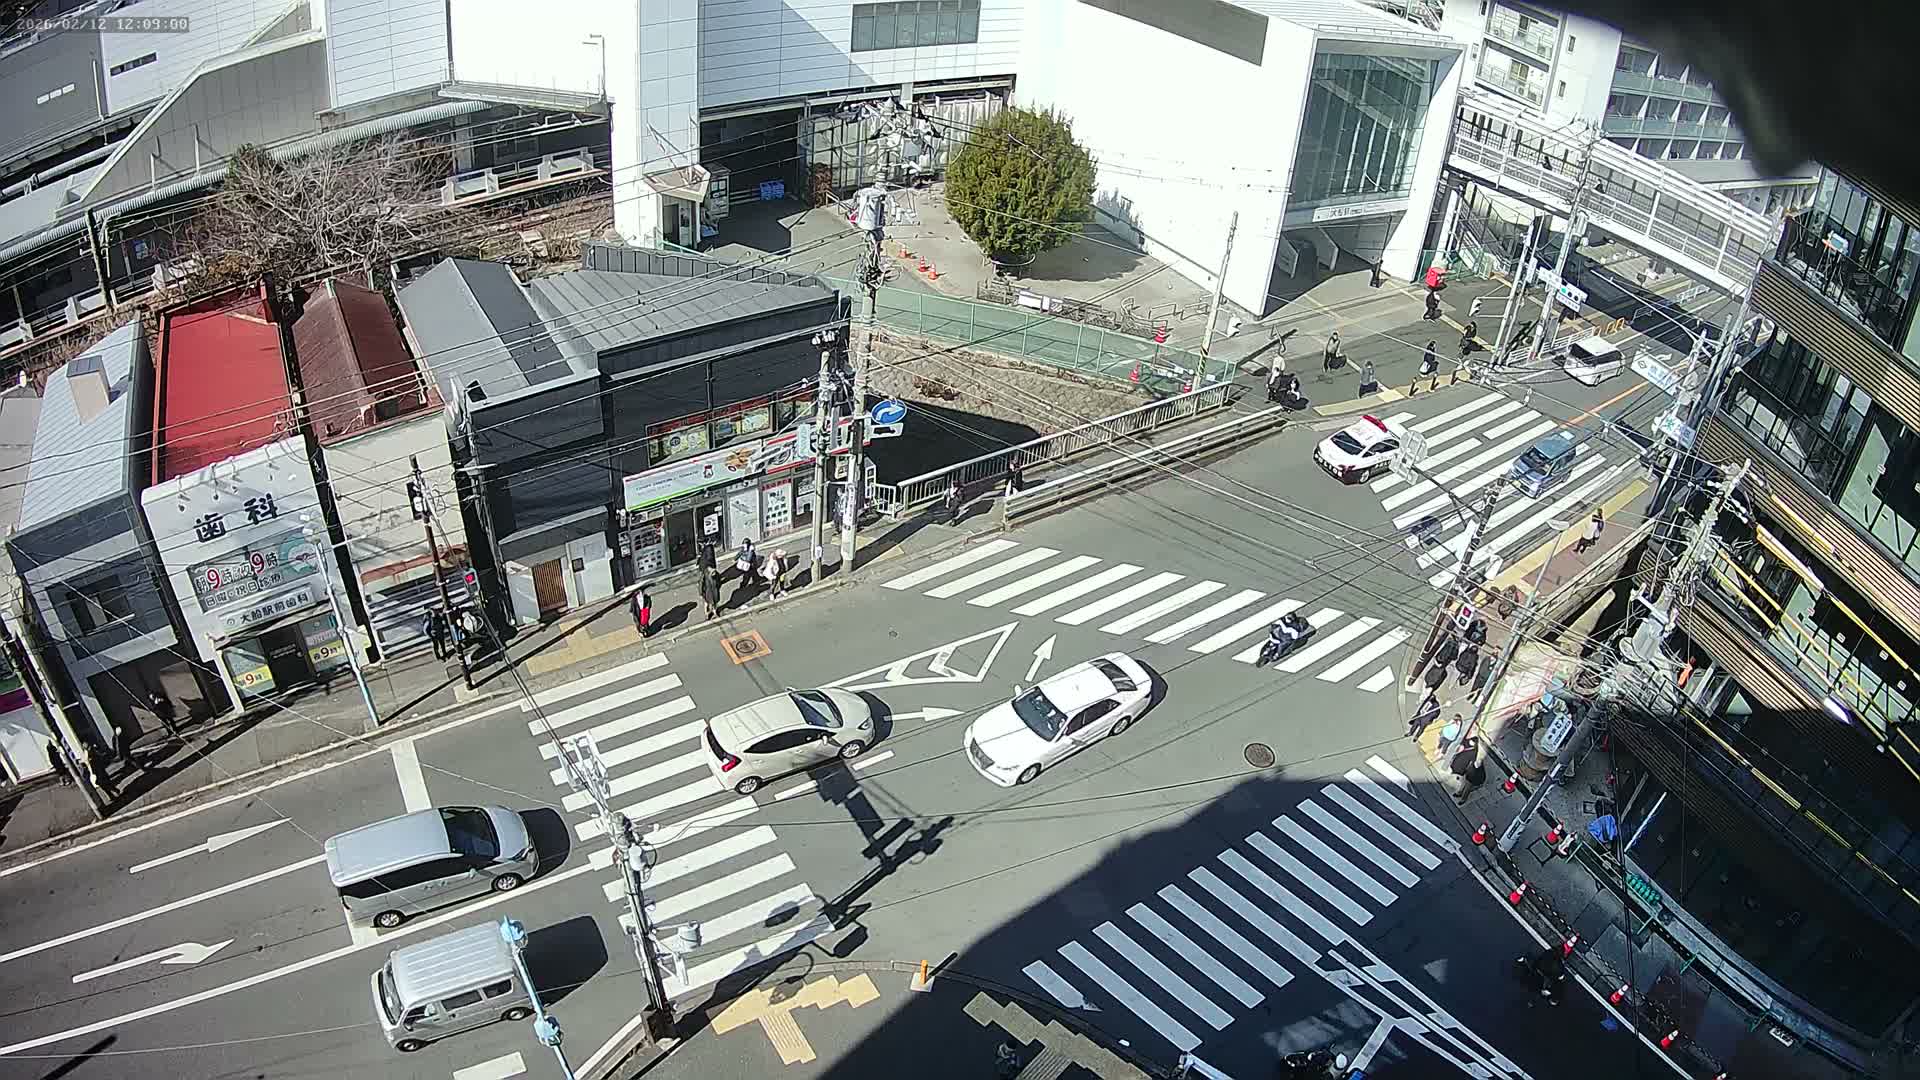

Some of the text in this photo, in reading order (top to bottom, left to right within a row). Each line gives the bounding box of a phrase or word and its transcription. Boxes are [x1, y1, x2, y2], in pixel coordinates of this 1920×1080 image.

[193, 493, 278, 542] 歯科
[241, 592, 309, 624] 大船駅前歯科
